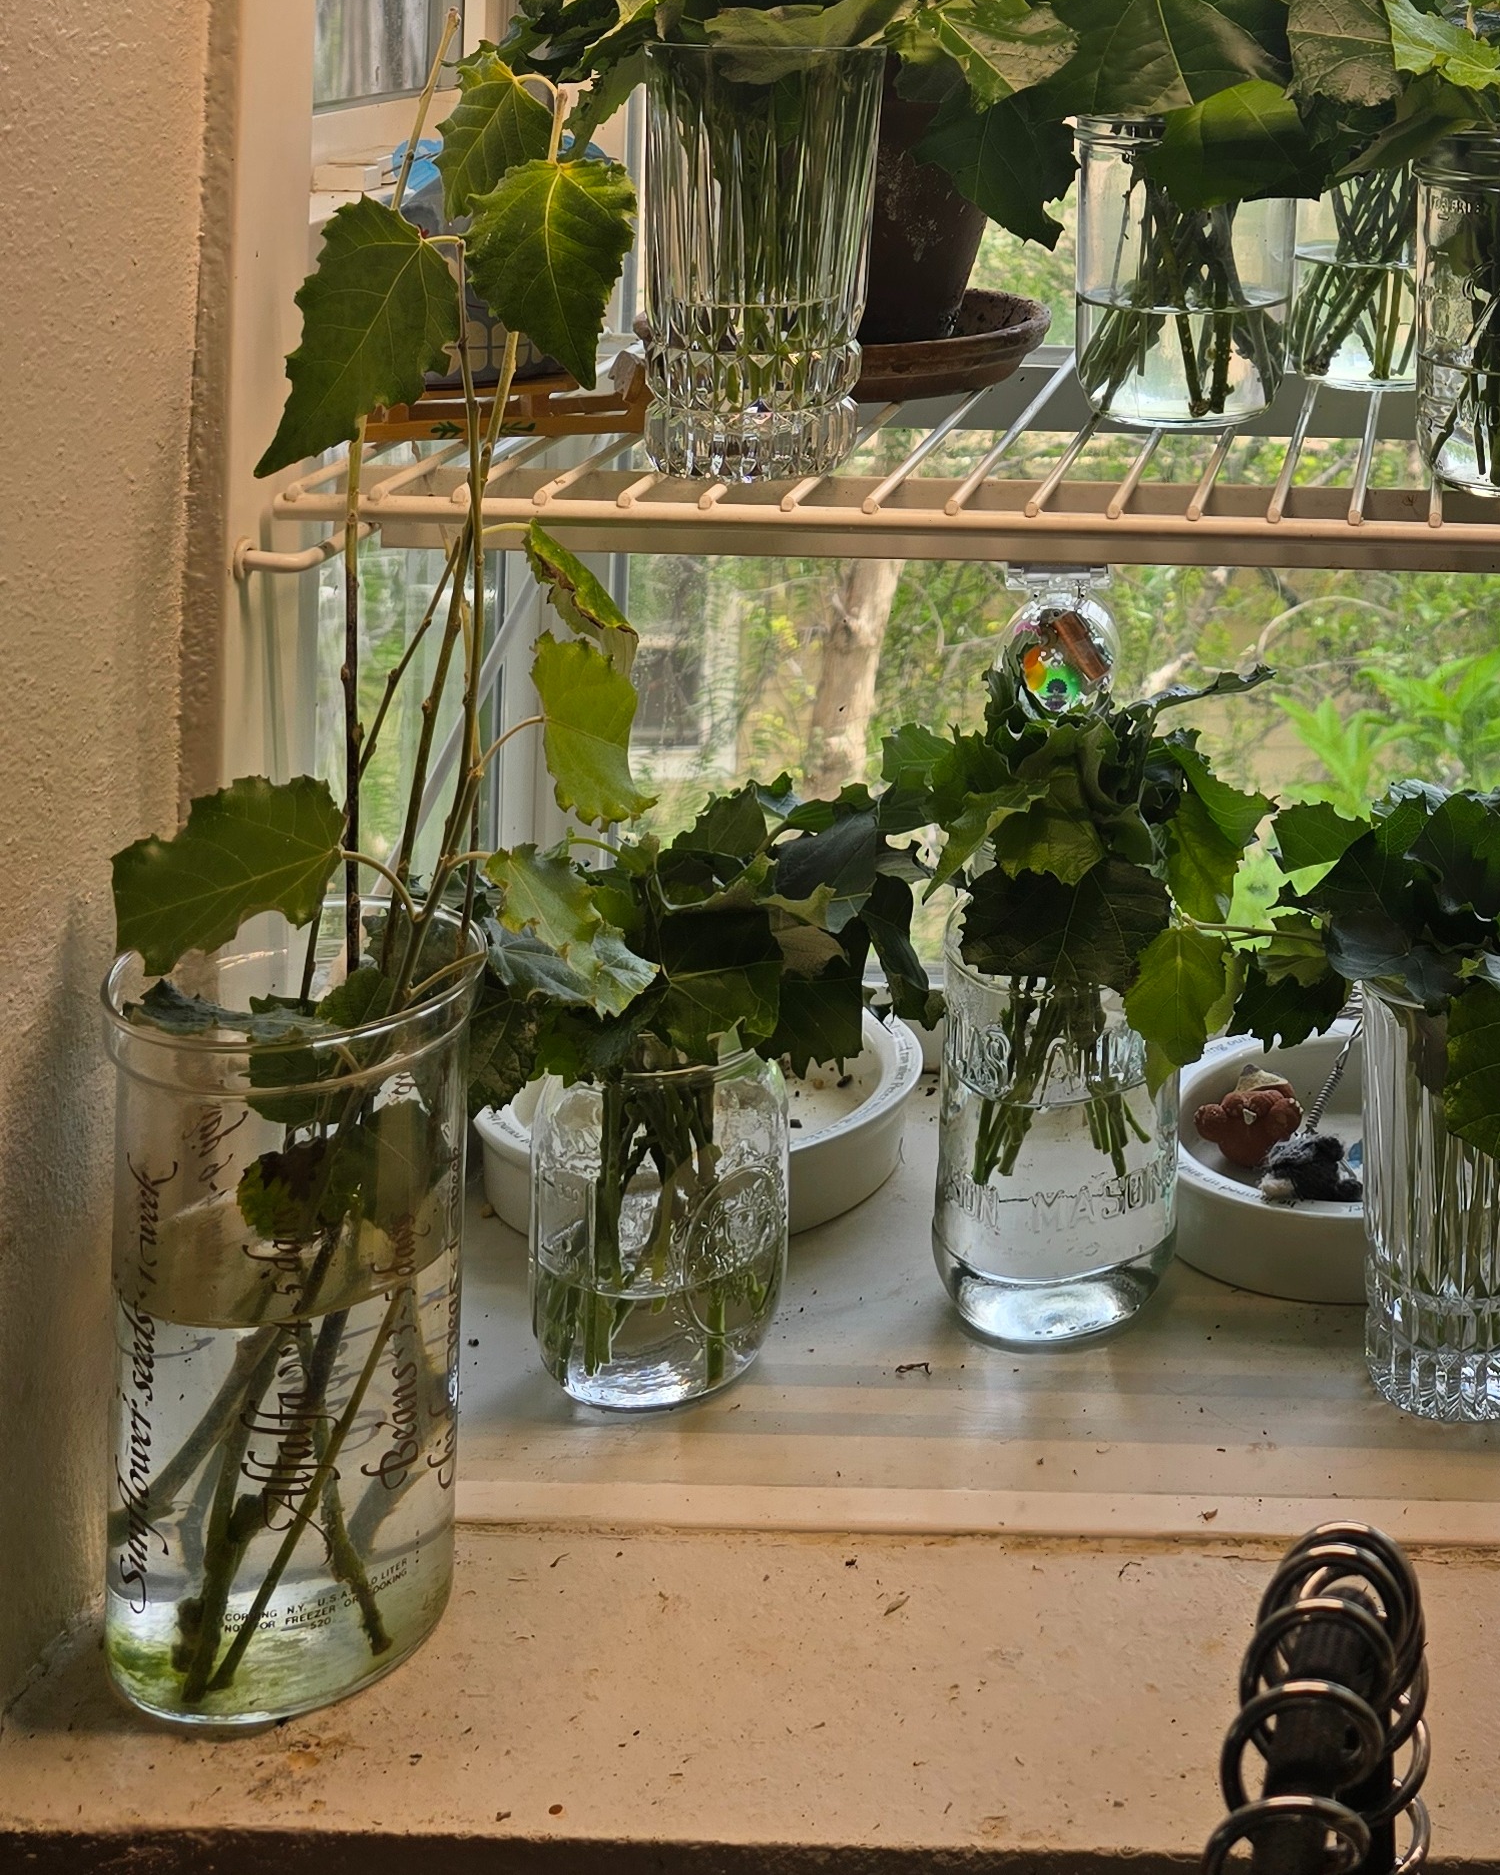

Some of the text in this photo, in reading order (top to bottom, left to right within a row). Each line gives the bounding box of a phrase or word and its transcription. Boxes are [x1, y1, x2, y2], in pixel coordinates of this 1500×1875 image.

[127, 1152, 178, 1268] week
[1027, 1161, 1172, 1233] MASON
[240, 1363, 341, 1566] Alfalfa
[361, 1361, 419, 1490] Beans
[224, 1608, 278, 1622] CORNG
[287, 1602, 306, 1616] N.Y.
[381, 1557, 408, 1581] LITER
[285, 1605, 336, 1626] FREEZER
[344, 1594, 360, 1608] OR
[365, 1567, 408, 1596] OOKING
